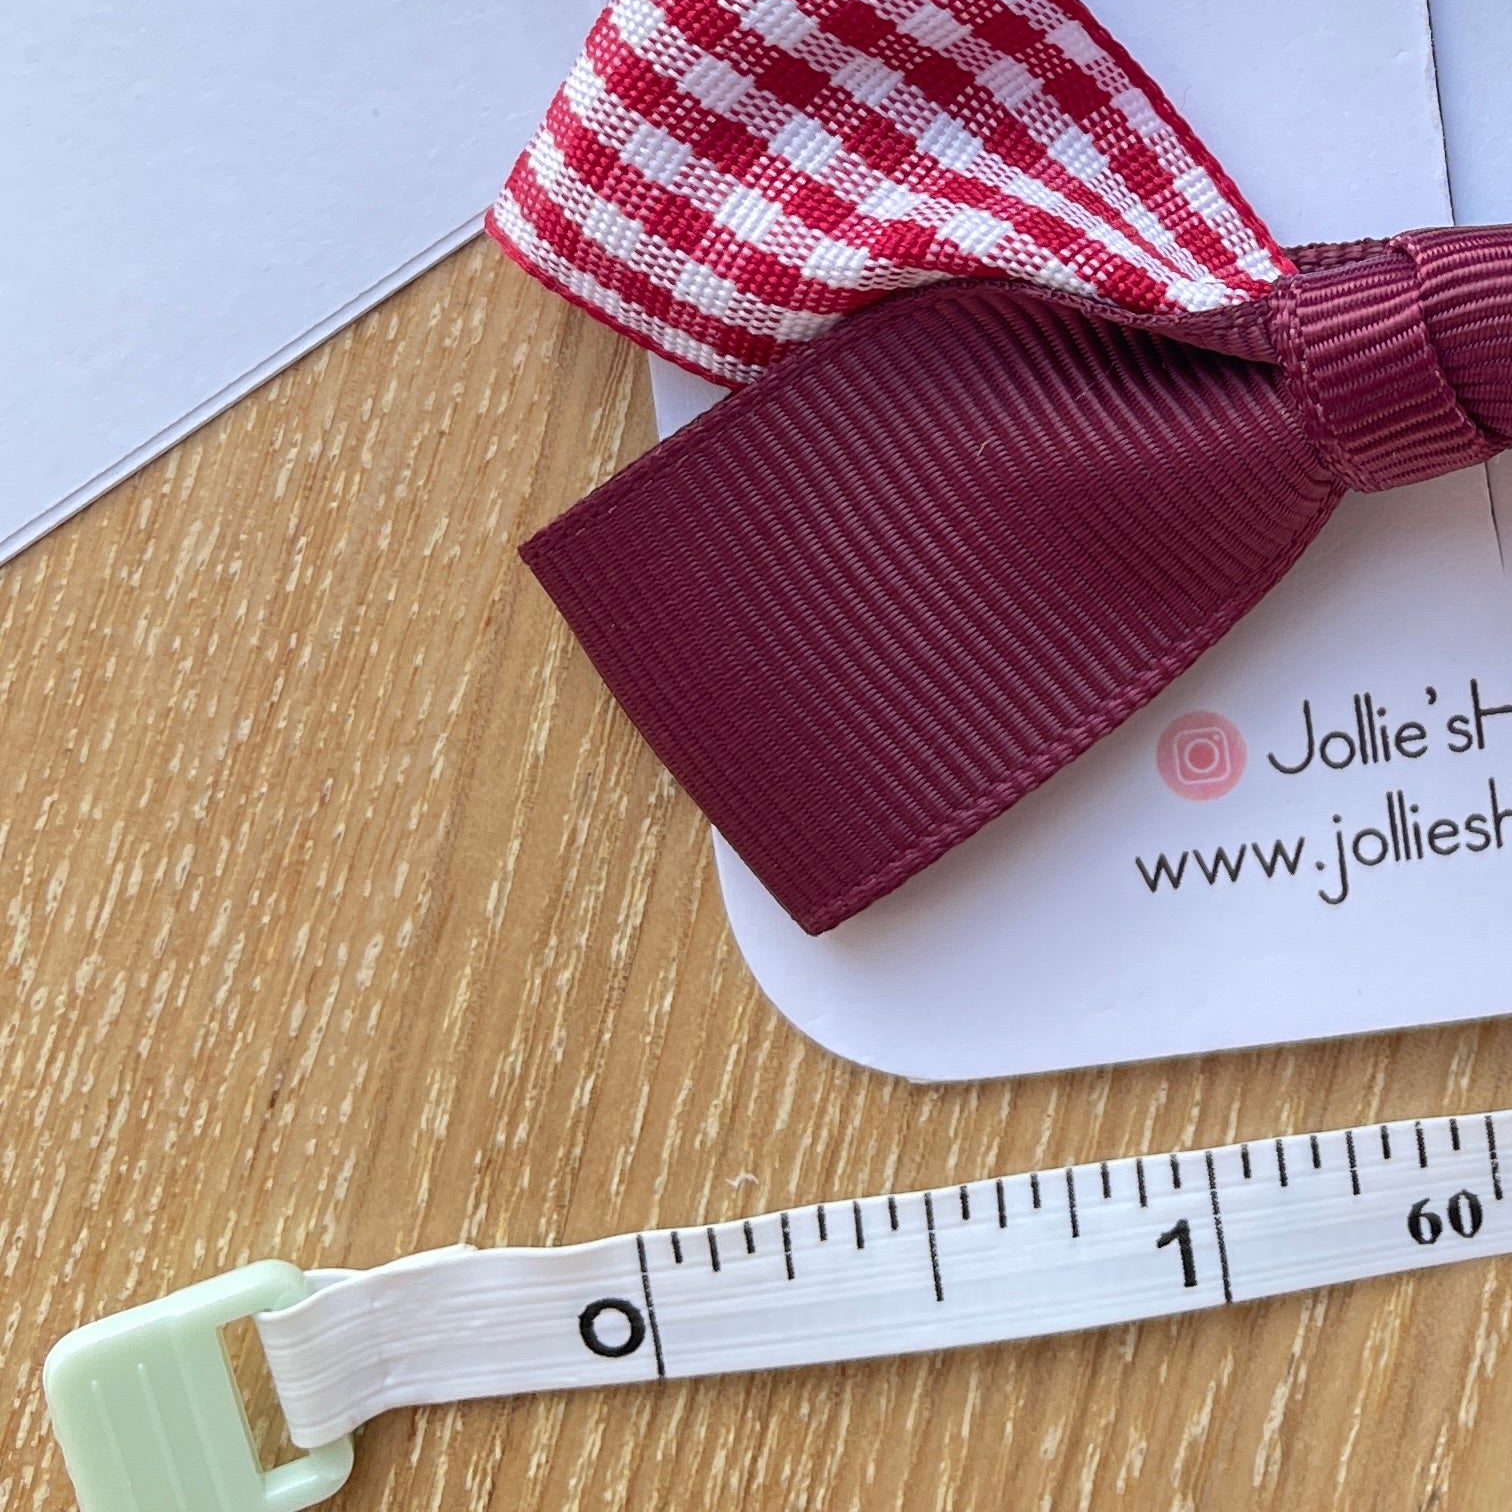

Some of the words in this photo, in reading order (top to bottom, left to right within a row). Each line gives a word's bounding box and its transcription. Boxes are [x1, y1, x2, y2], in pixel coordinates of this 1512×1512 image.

[1407, 1190, 1483, 1245] 60
[1156, 1220, 1198, 1288] 1
[578, 1297, 645, 1359] 0
